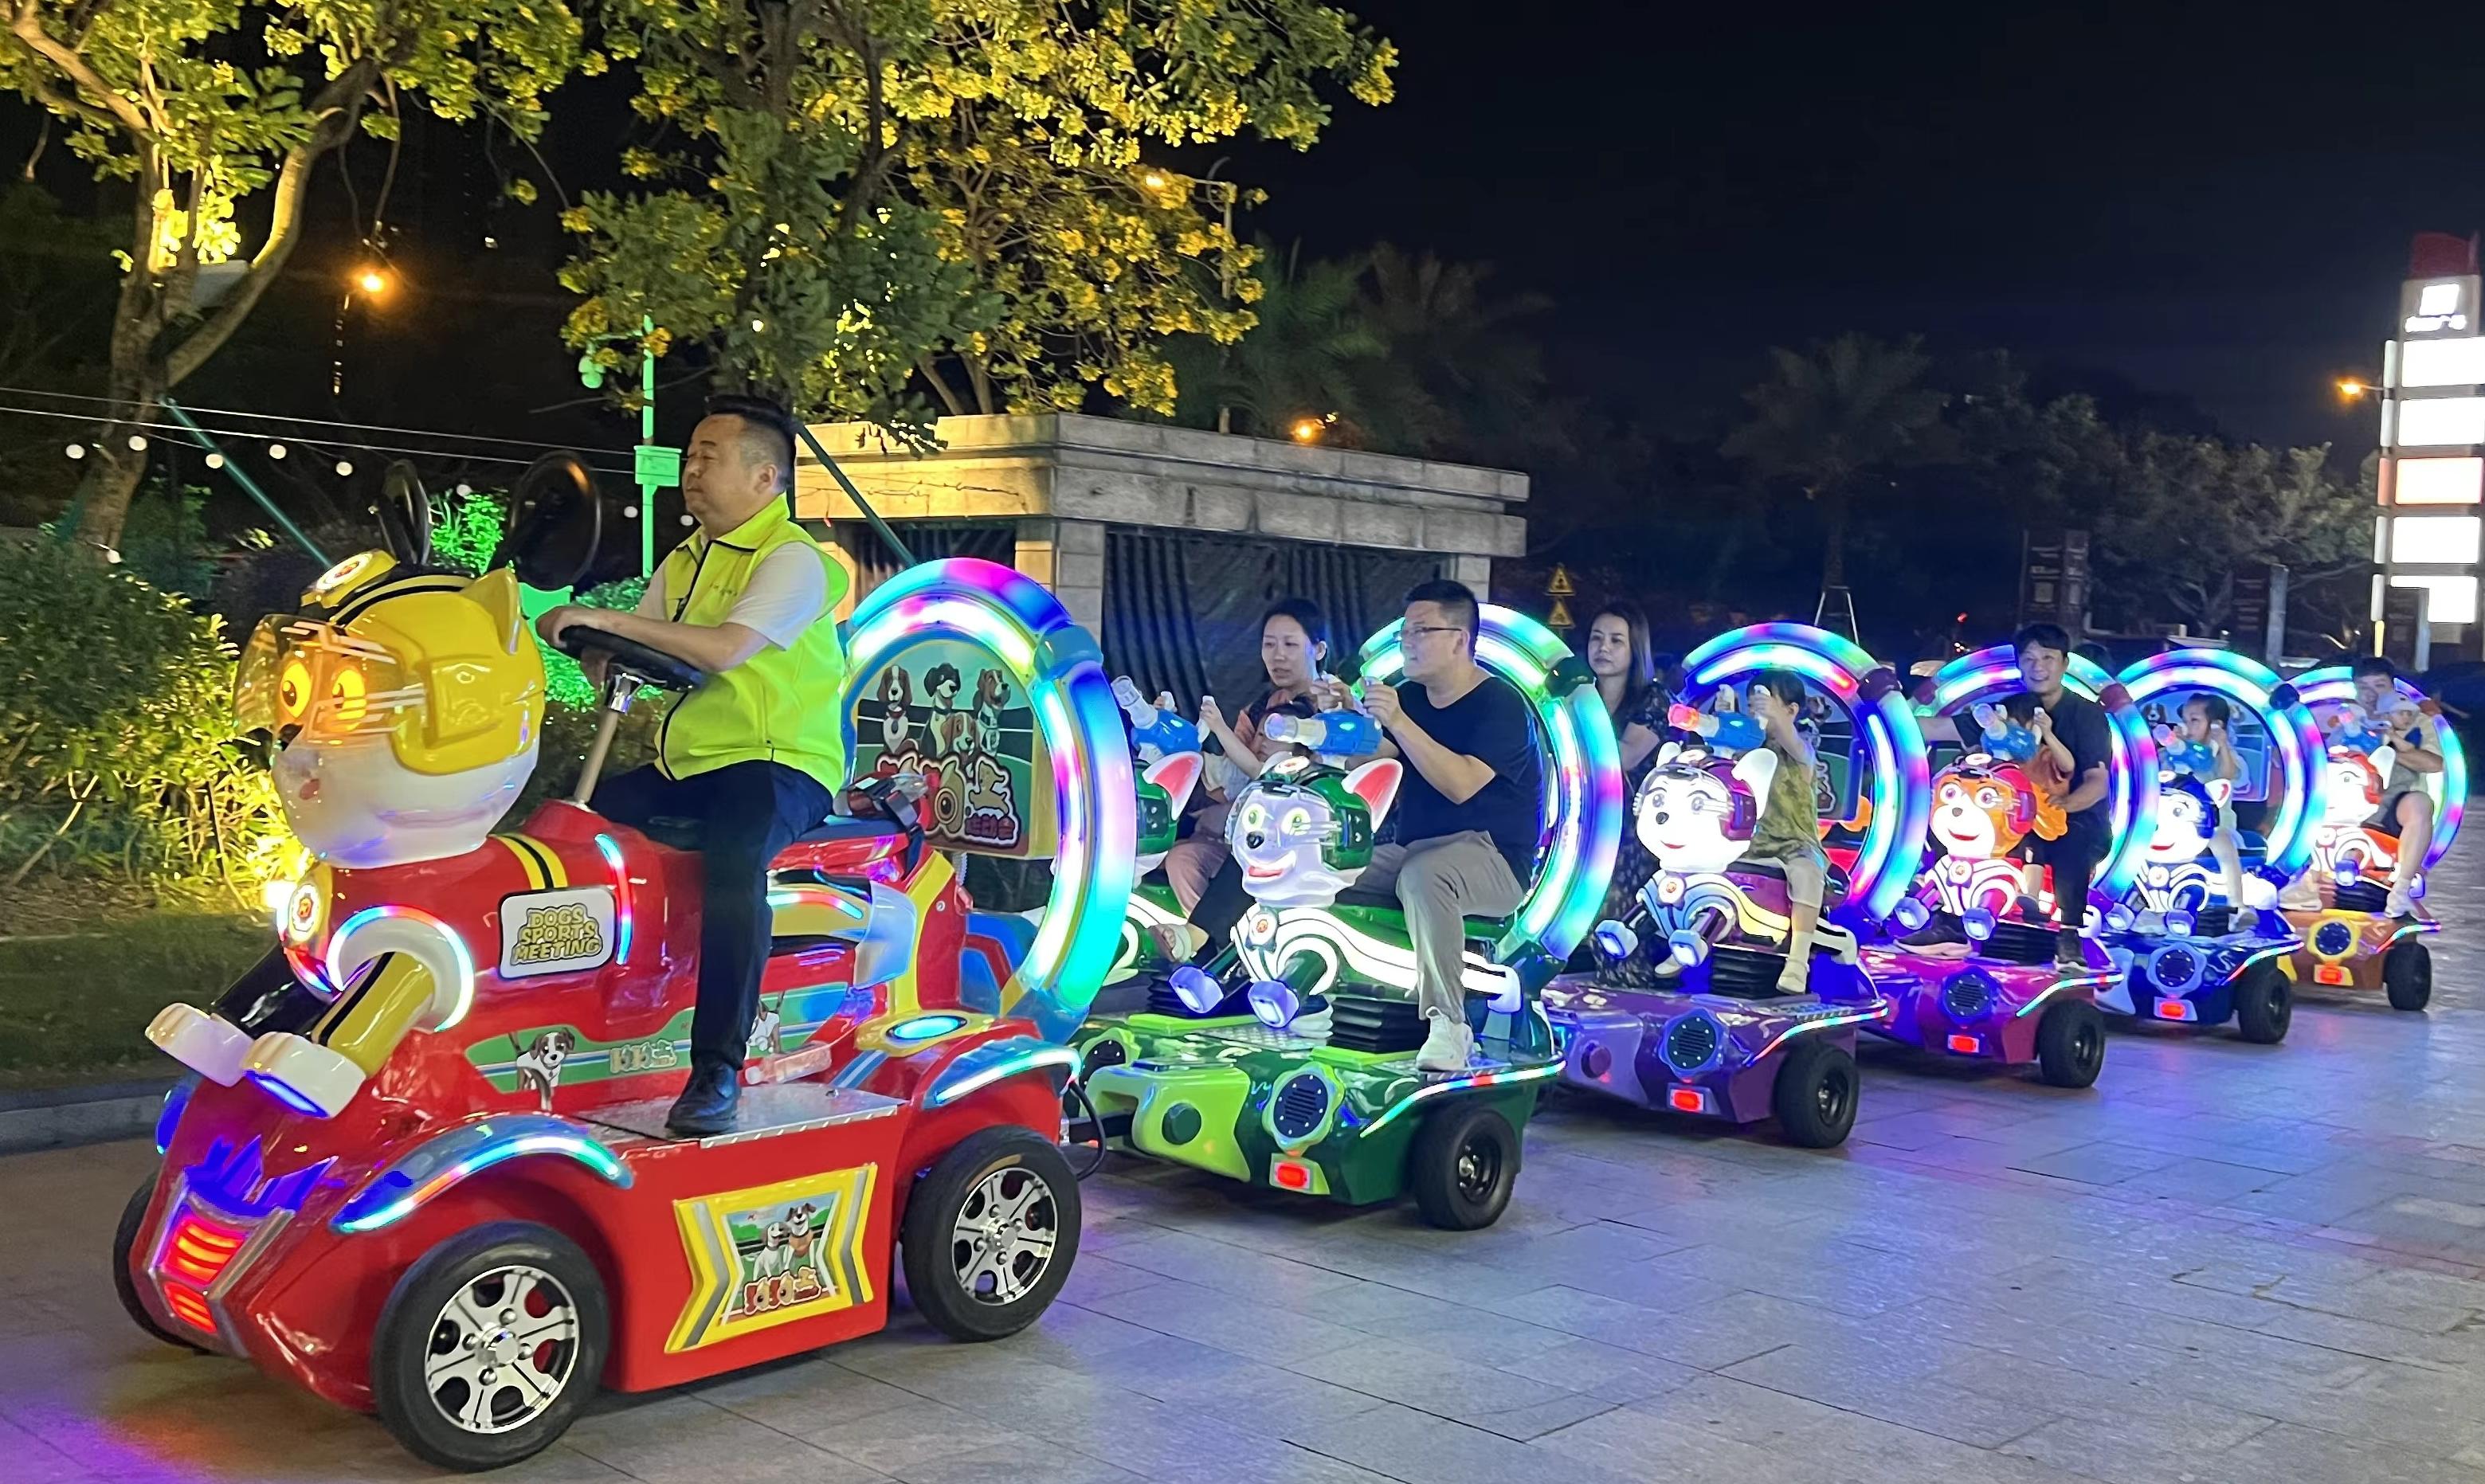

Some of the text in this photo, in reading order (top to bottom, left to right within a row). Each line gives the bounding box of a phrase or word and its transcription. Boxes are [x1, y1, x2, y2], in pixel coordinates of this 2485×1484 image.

[528, 906, 584, 928] DOGS
[519, 920, 597, 945] SPORTS
[514, 938, 602, 961] MEETING
